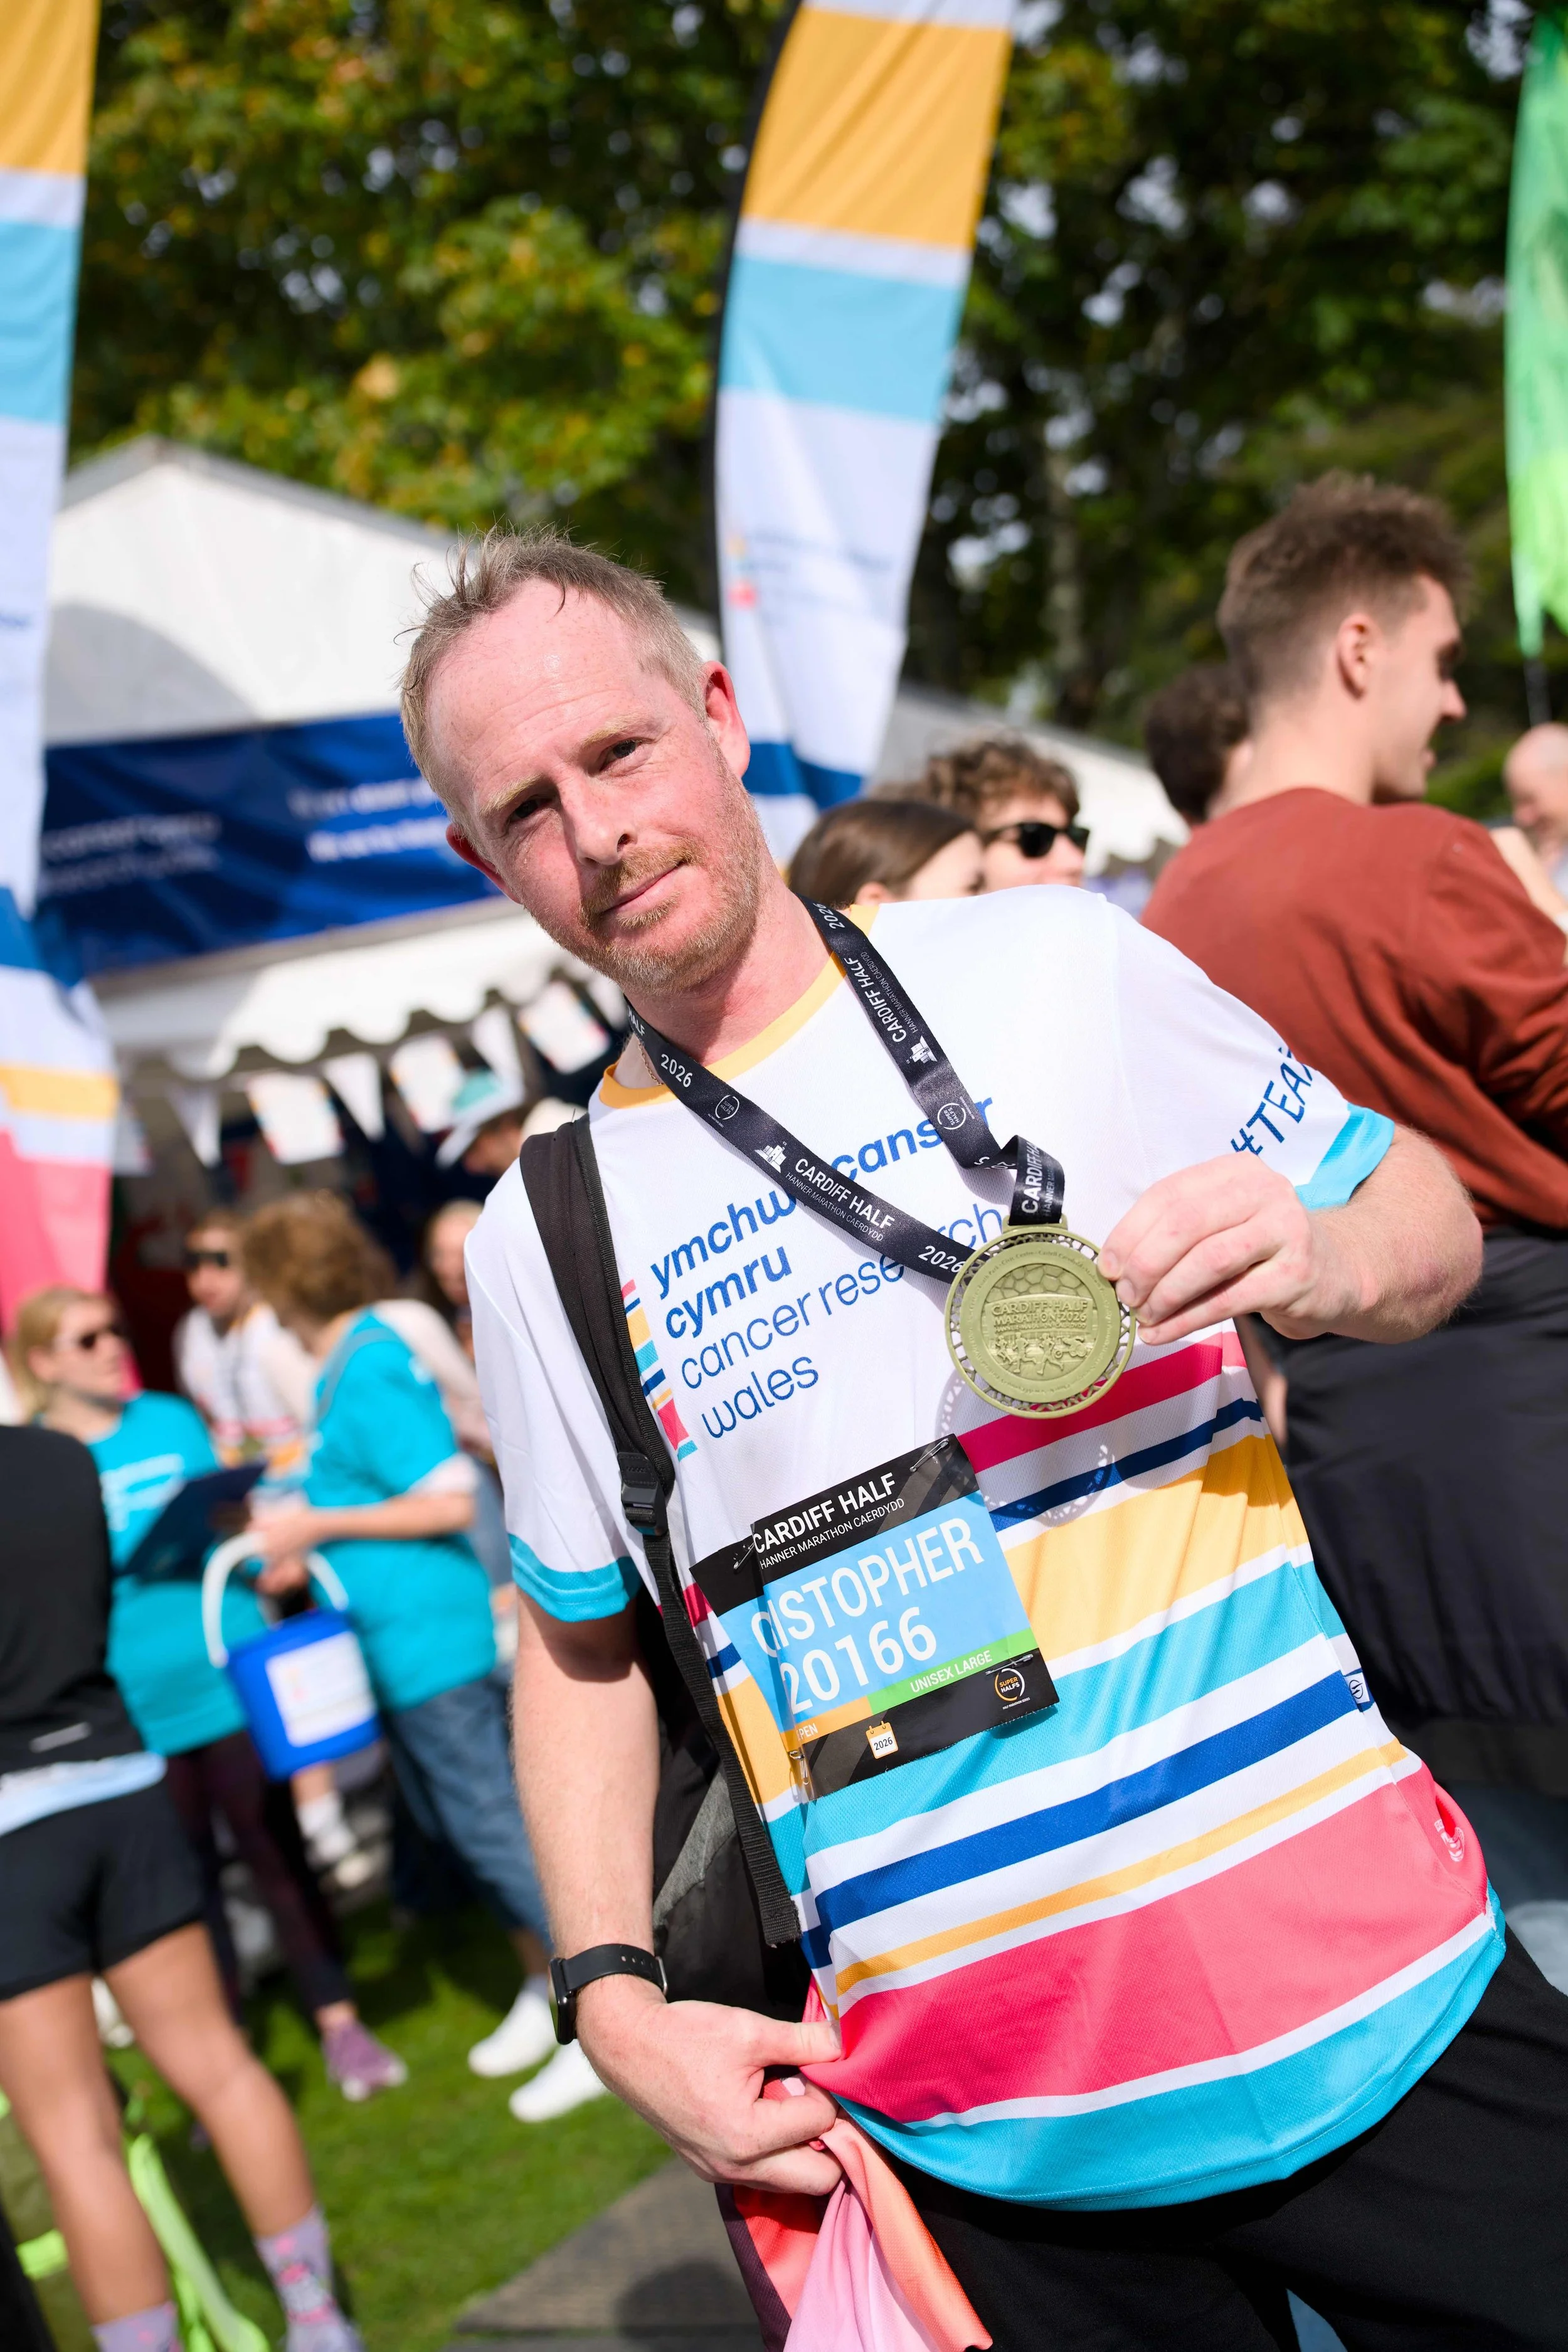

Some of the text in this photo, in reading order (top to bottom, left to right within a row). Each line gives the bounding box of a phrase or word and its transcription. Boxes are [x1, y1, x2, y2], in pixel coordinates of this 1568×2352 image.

[813, 903, 845, 929] 2026
[844, 958, 907, 1042] CARDIFF HALF
[861, 951, 919, 1034] HANNER MARATHON CAERDYDD
[660, 1054, 693, 1088] 2026
[720, 1104, 731, 1115] HALFS
[723, 1100, 736, 1112] SUPER
[943, 1110, 956, 1125] SUPER
[948, 1107, 960, 1123] HALFS
[650, 1098, 993, 1301] ymchw cansr
[795, 1158, 895, 1229] CARDIFF HALF
[1021, 1153, 1043, 1214] CARDIFF
[785, 1172, 884, 1241] HANNER MARATHON CAERDYDD
[918, 1245, 967, 1273] 2026
[666, 1246, 792, 1338] cymru
[681, 1204, 1002, 1389] cancer resech
[1060, 1311, 1088, 1322] 2026
[702, 1357, 818, 1438] wales
[753, 1472, 896, 1554] CARDIFF HALF
[760, 1498, 905, 1570] HANNER MARATHON CAERDYDD
[780, 1606, 937, 1715] 20166
[910, 1650, 992, 1693] UNISEX LARGE
[999, 1676, 1019, 1688] SUPER
[1000, 1682, 1020, 1693] HALFS
[798, 1723, 818, 1741] PEN
[874, 1737, 893, 1751] 2026
